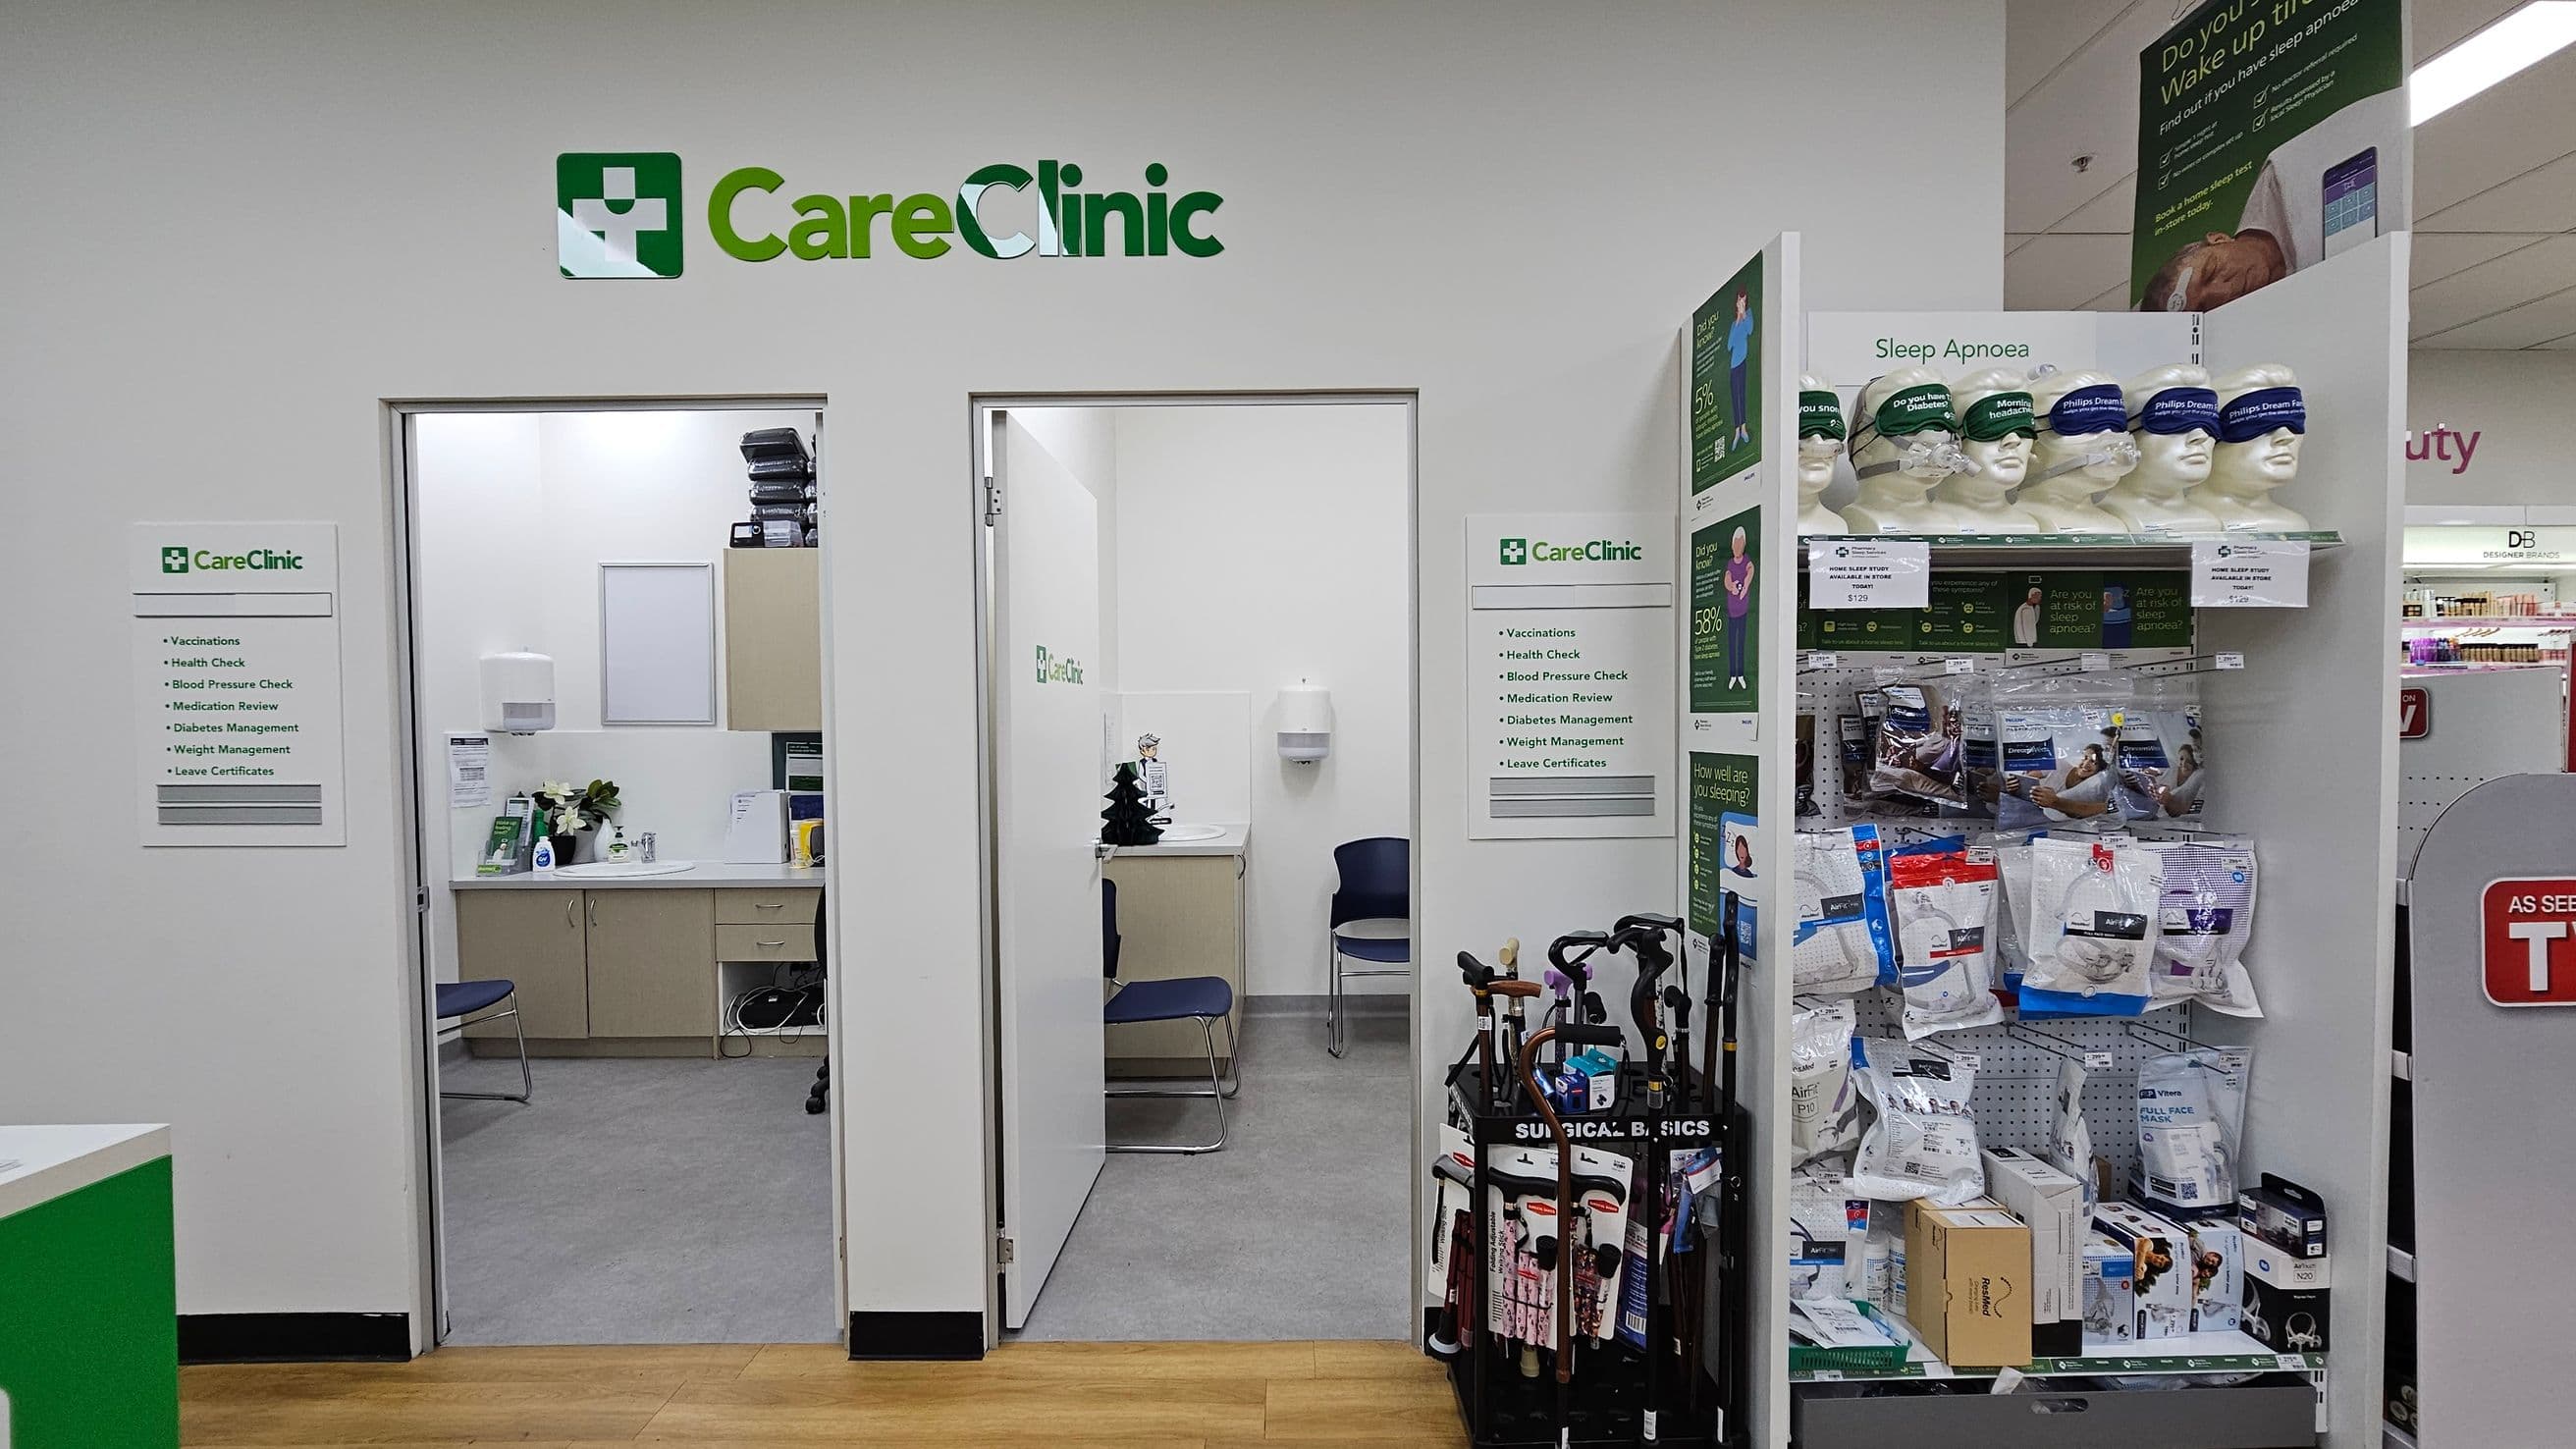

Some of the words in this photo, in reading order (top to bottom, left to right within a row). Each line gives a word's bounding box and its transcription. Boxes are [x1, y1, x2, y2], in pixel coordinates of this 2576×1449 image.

[2163, 37, 2194, 73] Do
[2200, 0, 2244, 53] you
[2161, 48, 2227, 106] Wake
[2232, 20, 2266, 52] up
[2272, 0, 2313, 26] tir
[2160, 111, 2182, 135] Find
[2183, 95, 2202, 119] out
[2204, 89, 2214, 105] if
[2214, 77, 2235, 102] you
[2238, 56, 2268, 82] have
[2269, 31, 2303, 62] sleep
[2155, 205, 2175, 223] Book
[2183, 187, 2208, 206] home
[2210, 173, 2234, 192] sleep
[2234, 161, 2252, 177] test
[707, 159, 1225, 263] CareClinic
[2155, 214, 2186, 237] in-store
[2187, 199, 2214, 218] today.
[1875, 338, 1936, 364] Sleep
[1943, 339, 2030, 365] Apnoea
[1695, 379, 1714, 414] 5%
[1893, 399, 1906, 409] Do
[1907, 396, 1926, 407] you
[1927, 393, 1946, 404] have
[2063, 398, 2093, 409] Philips
[2095, 397, 2119, 405] Dream
[2155, 401, 2185, 410] Philips
[2187, 401, 2214, 409] Dream
[2229, 404, 2261, 419] Philips
[2262, 402, 2290, 410] Dream
[1531, 540, 1642, 563] CareClinic
[1695, 544, 1706, 558] Did
[1706, 541, 1718, 557] you
[2483, 551, 2525, 560] DESIGNER
[2525, 551, 2560, 560] BRANDS
[193, 549, 303, 571] CareClinic
[1695, 555, 1713, 571] know?
[1848, 594, 1868, 603] $129
[2050, 589, 2069, 600] Are
[2071, 591, 2092, 602] you
[2136, 587, 2157, 598] Are
[2159, 588, 2178, 599] you
[2050, 601, 2062, 611] at
[2064, 601, 2083, 611] risk
[2085, 600, 2097, 611] of
[2136, 598, 2149, 608] at
[2150, 597, 2171, 608] risk
[2172, 597, 2183, 607] of
[1694, 606, 1722, 636] 58%
[2050, 612, 2078, 624] sleep
[2136, 609, 2166, 621] sleep
[1506, 627, 1577, 638] Vaccinations
[2049, 623, 2097, 636] apnoea?
[2136, 620, 2183, 633] apnoea?
[171, 635, 241, 647] Vaccinations
[1506, 649, 1544, 660] Health
[1546, 649, 1581, 660] Check
[171, 657, 208, 668] Health
[211, 657, 245, 668] Check
[1047, 653, 1084, 685] CareClinic
[1506, 671, 1539, 681] Blood
[1542, 671, 1590, 681] Pressure
[1593, 671, 1628, 680] Check
[172, 678, 204, 689] Blood
[208, 679, 256, 690] Pressure
[259, 678, 294, 689] Check
[1506, 692, 1570, 704] Medication
[1572, 692, 1613, 703] Review
[2402, 694, 2417, 703] ON
[172, 700, 235, 711] Medication
[238, 700, 279, 711] Review
[1507, 714, 1557, 725] Diabetes
[1559, 714, 1634, 727] Management
[173, 722, 223, 733] Diabetes
[226, 722, 299, 735] Management
[1506, 736, 1547, 749] Weight
[1550, 735, 1625, 748] Management
[174, 743, 215, 756] Weight
[218, 743, 291, 757] Management
[1507, 758, 1539, 769] Leave
[1542, 757, 1607, 769] Certificates
[175, 765, 207, 777] Leave
[210, 765, 274, 776] Certificates
[1693, 762, 1713, 779] How
[1714, 764, 1732, 783] well
[1733, 770, 1748, 784] are
[1693, 784, 1709, 799] you
[1709, 782, 1750, 807] sleeping?
[2508, 896, 2538, 914] AS
[2508, 921, 2576, 993] T
[1798, 1101, 1815, 1114] P10
[2140, 1106, 2167, 1115] FULL
[2168, 1106, 2195, 1115] FACE
[2140, 1114, 2173, 1123] MASK
[1631, 1120, 1710, 1137] BSICS
[1981, 1276, 1992, 1317] ResMed
